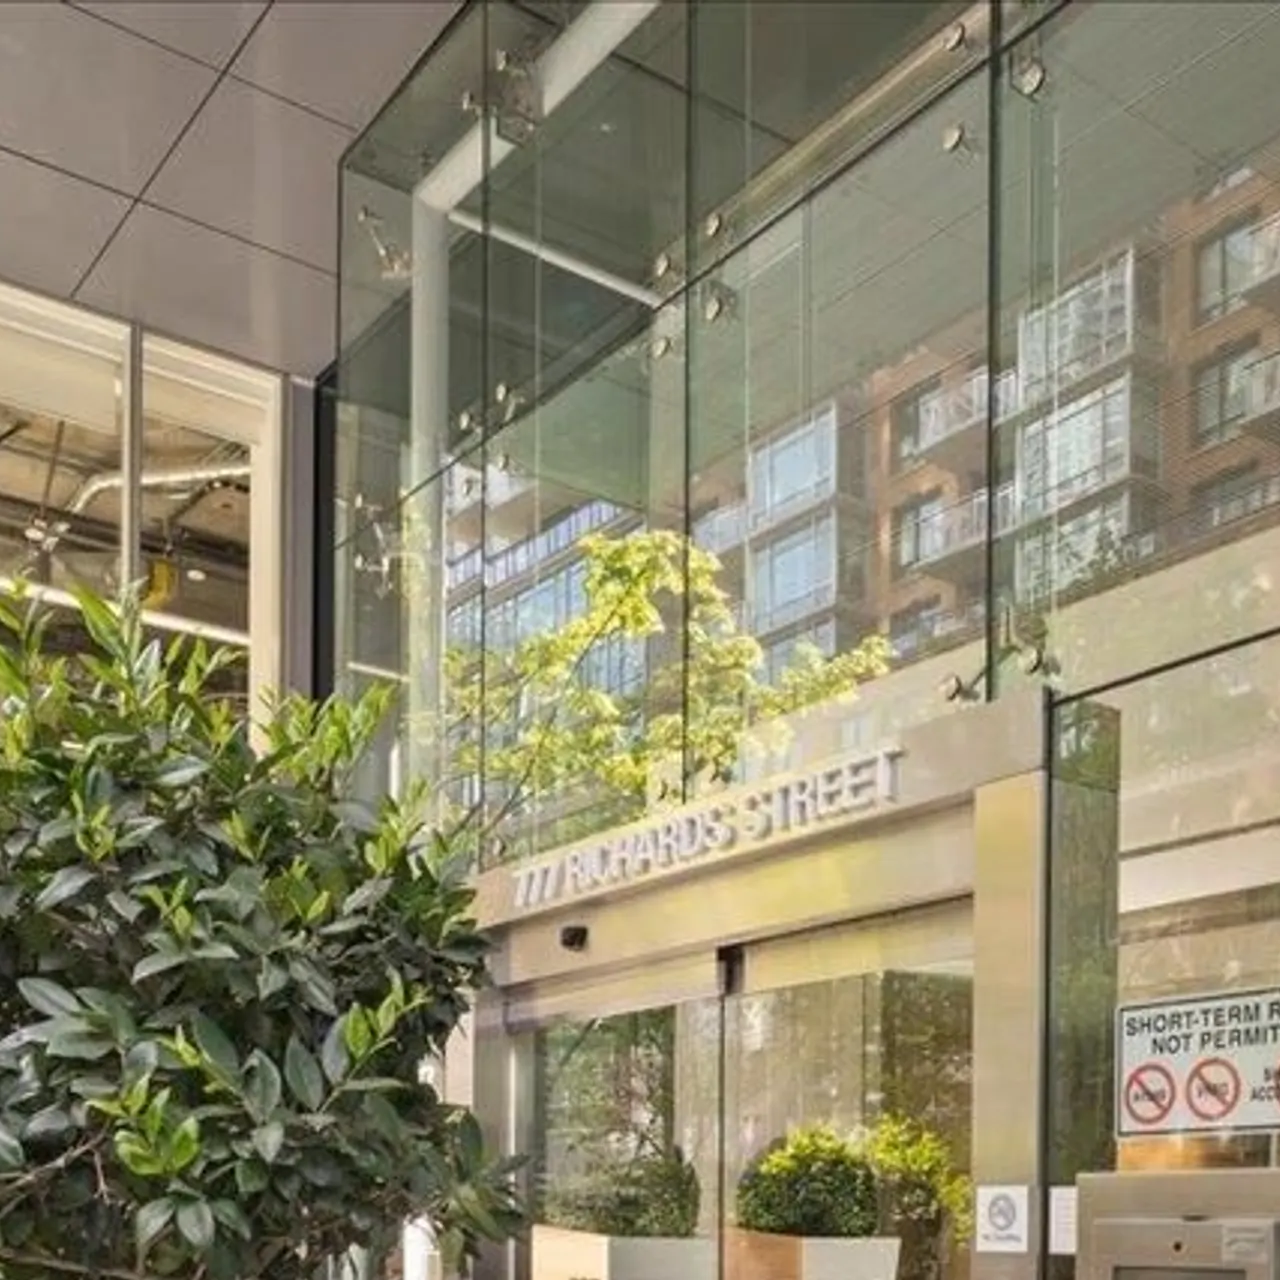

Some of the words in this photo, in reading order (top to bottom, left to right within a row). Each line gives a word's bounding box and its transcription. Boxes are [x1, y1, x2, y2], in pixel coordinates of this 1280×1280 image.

[513, 868, 560, 908] 777
[565, 810, 732, 893] RICHARDS
[742, 748, 906, 841] STREET
[1125, 1003, 1261, 1036] SHORT-TERM
[1152, 1034, 1194, 1054] NOT
